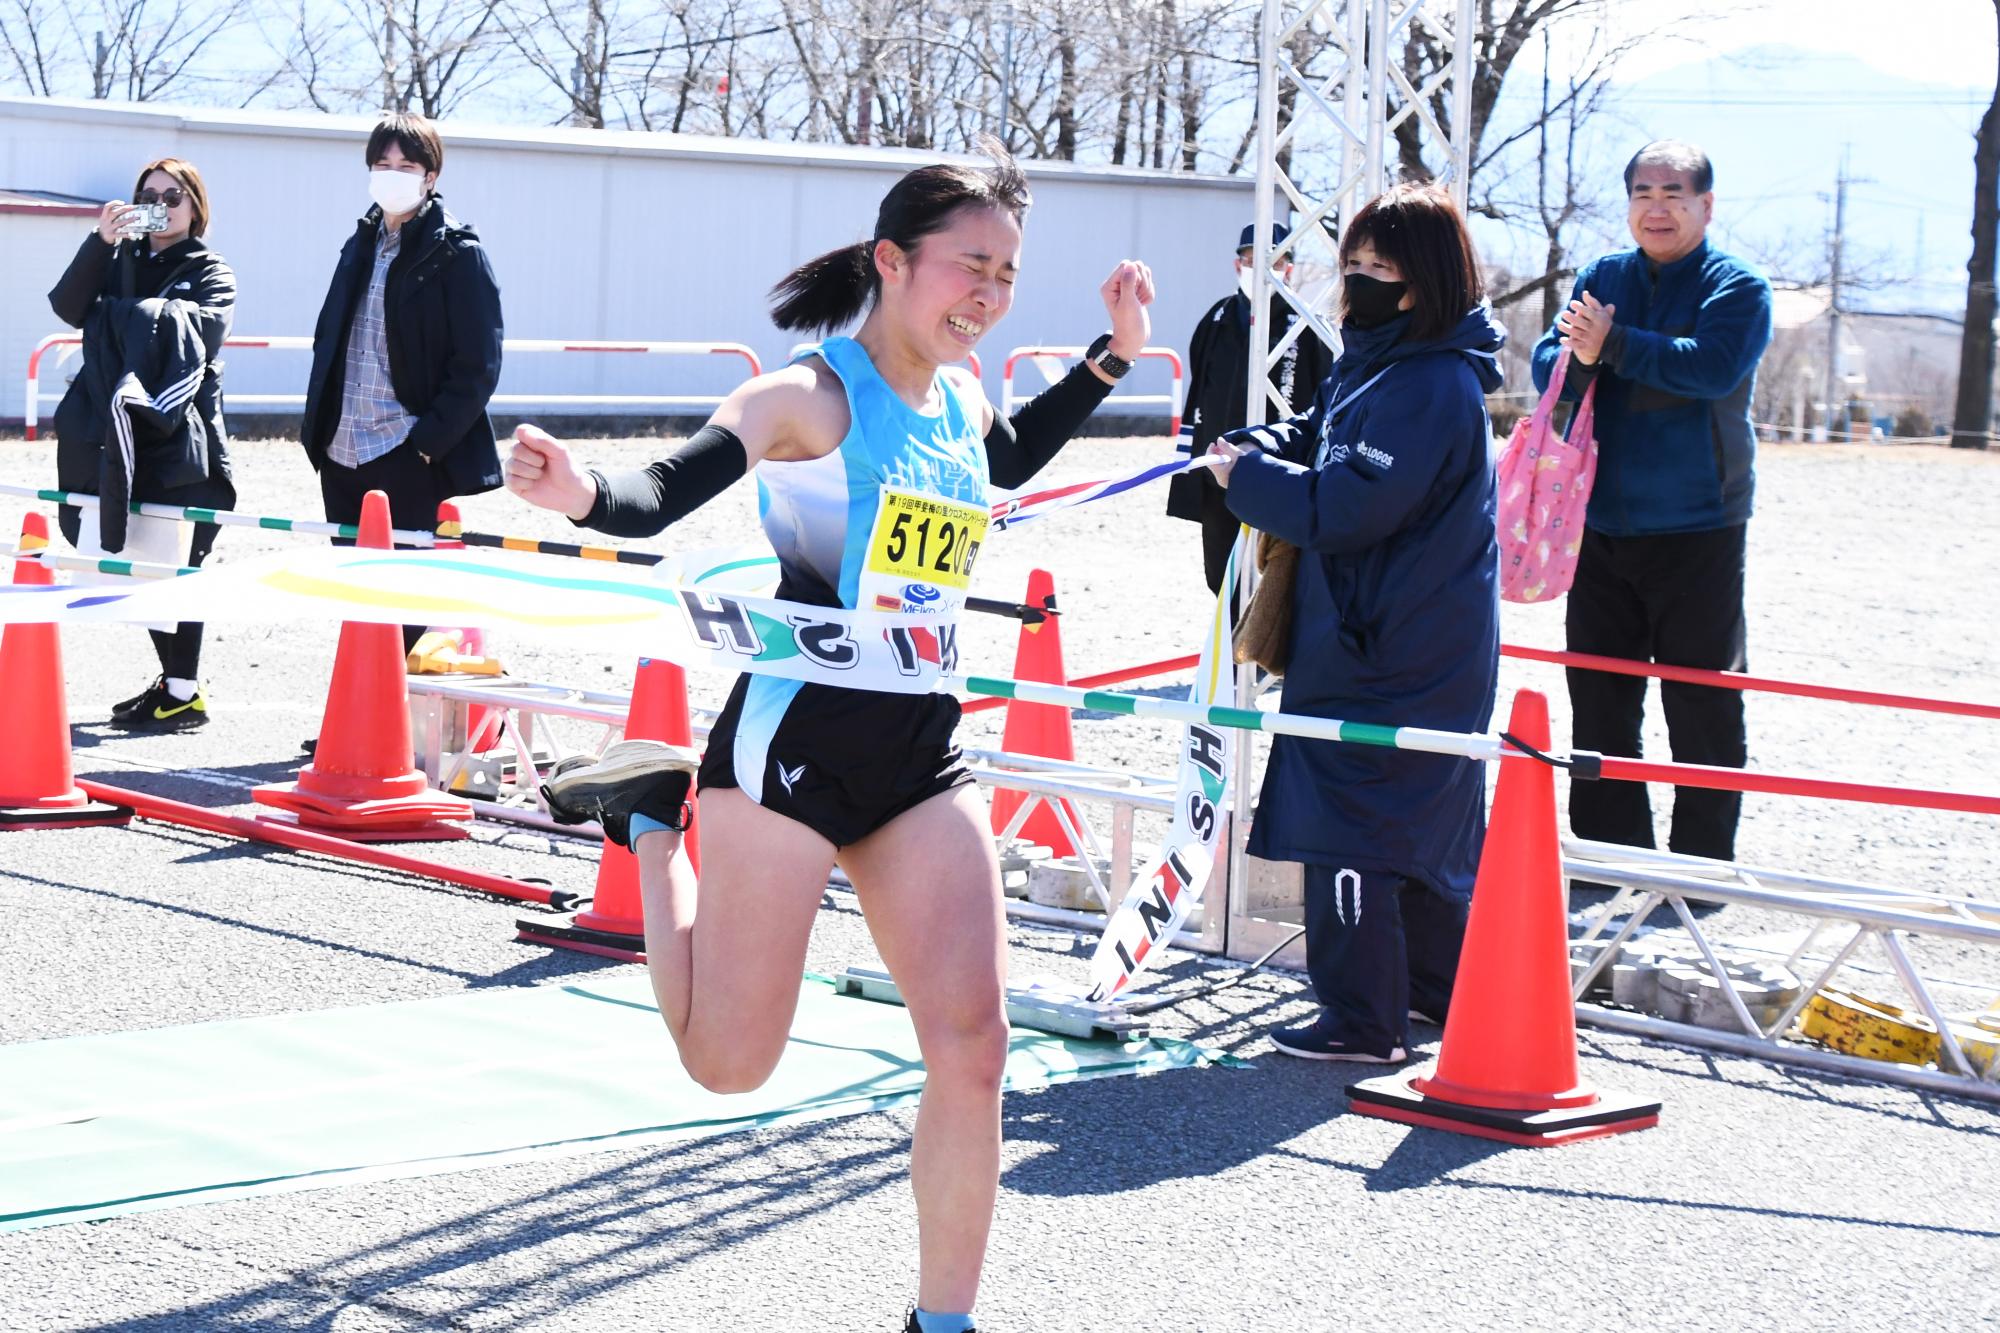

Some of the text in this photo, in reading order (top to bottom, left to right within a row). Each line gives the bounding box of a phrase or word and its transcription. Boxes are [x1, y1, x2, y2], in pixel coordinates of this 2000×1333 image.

[1367, 446, 1394, 466] LOGOS
[886, 512, 969, 575] 5120
[1087, 723, 1225, 1000] INISH
